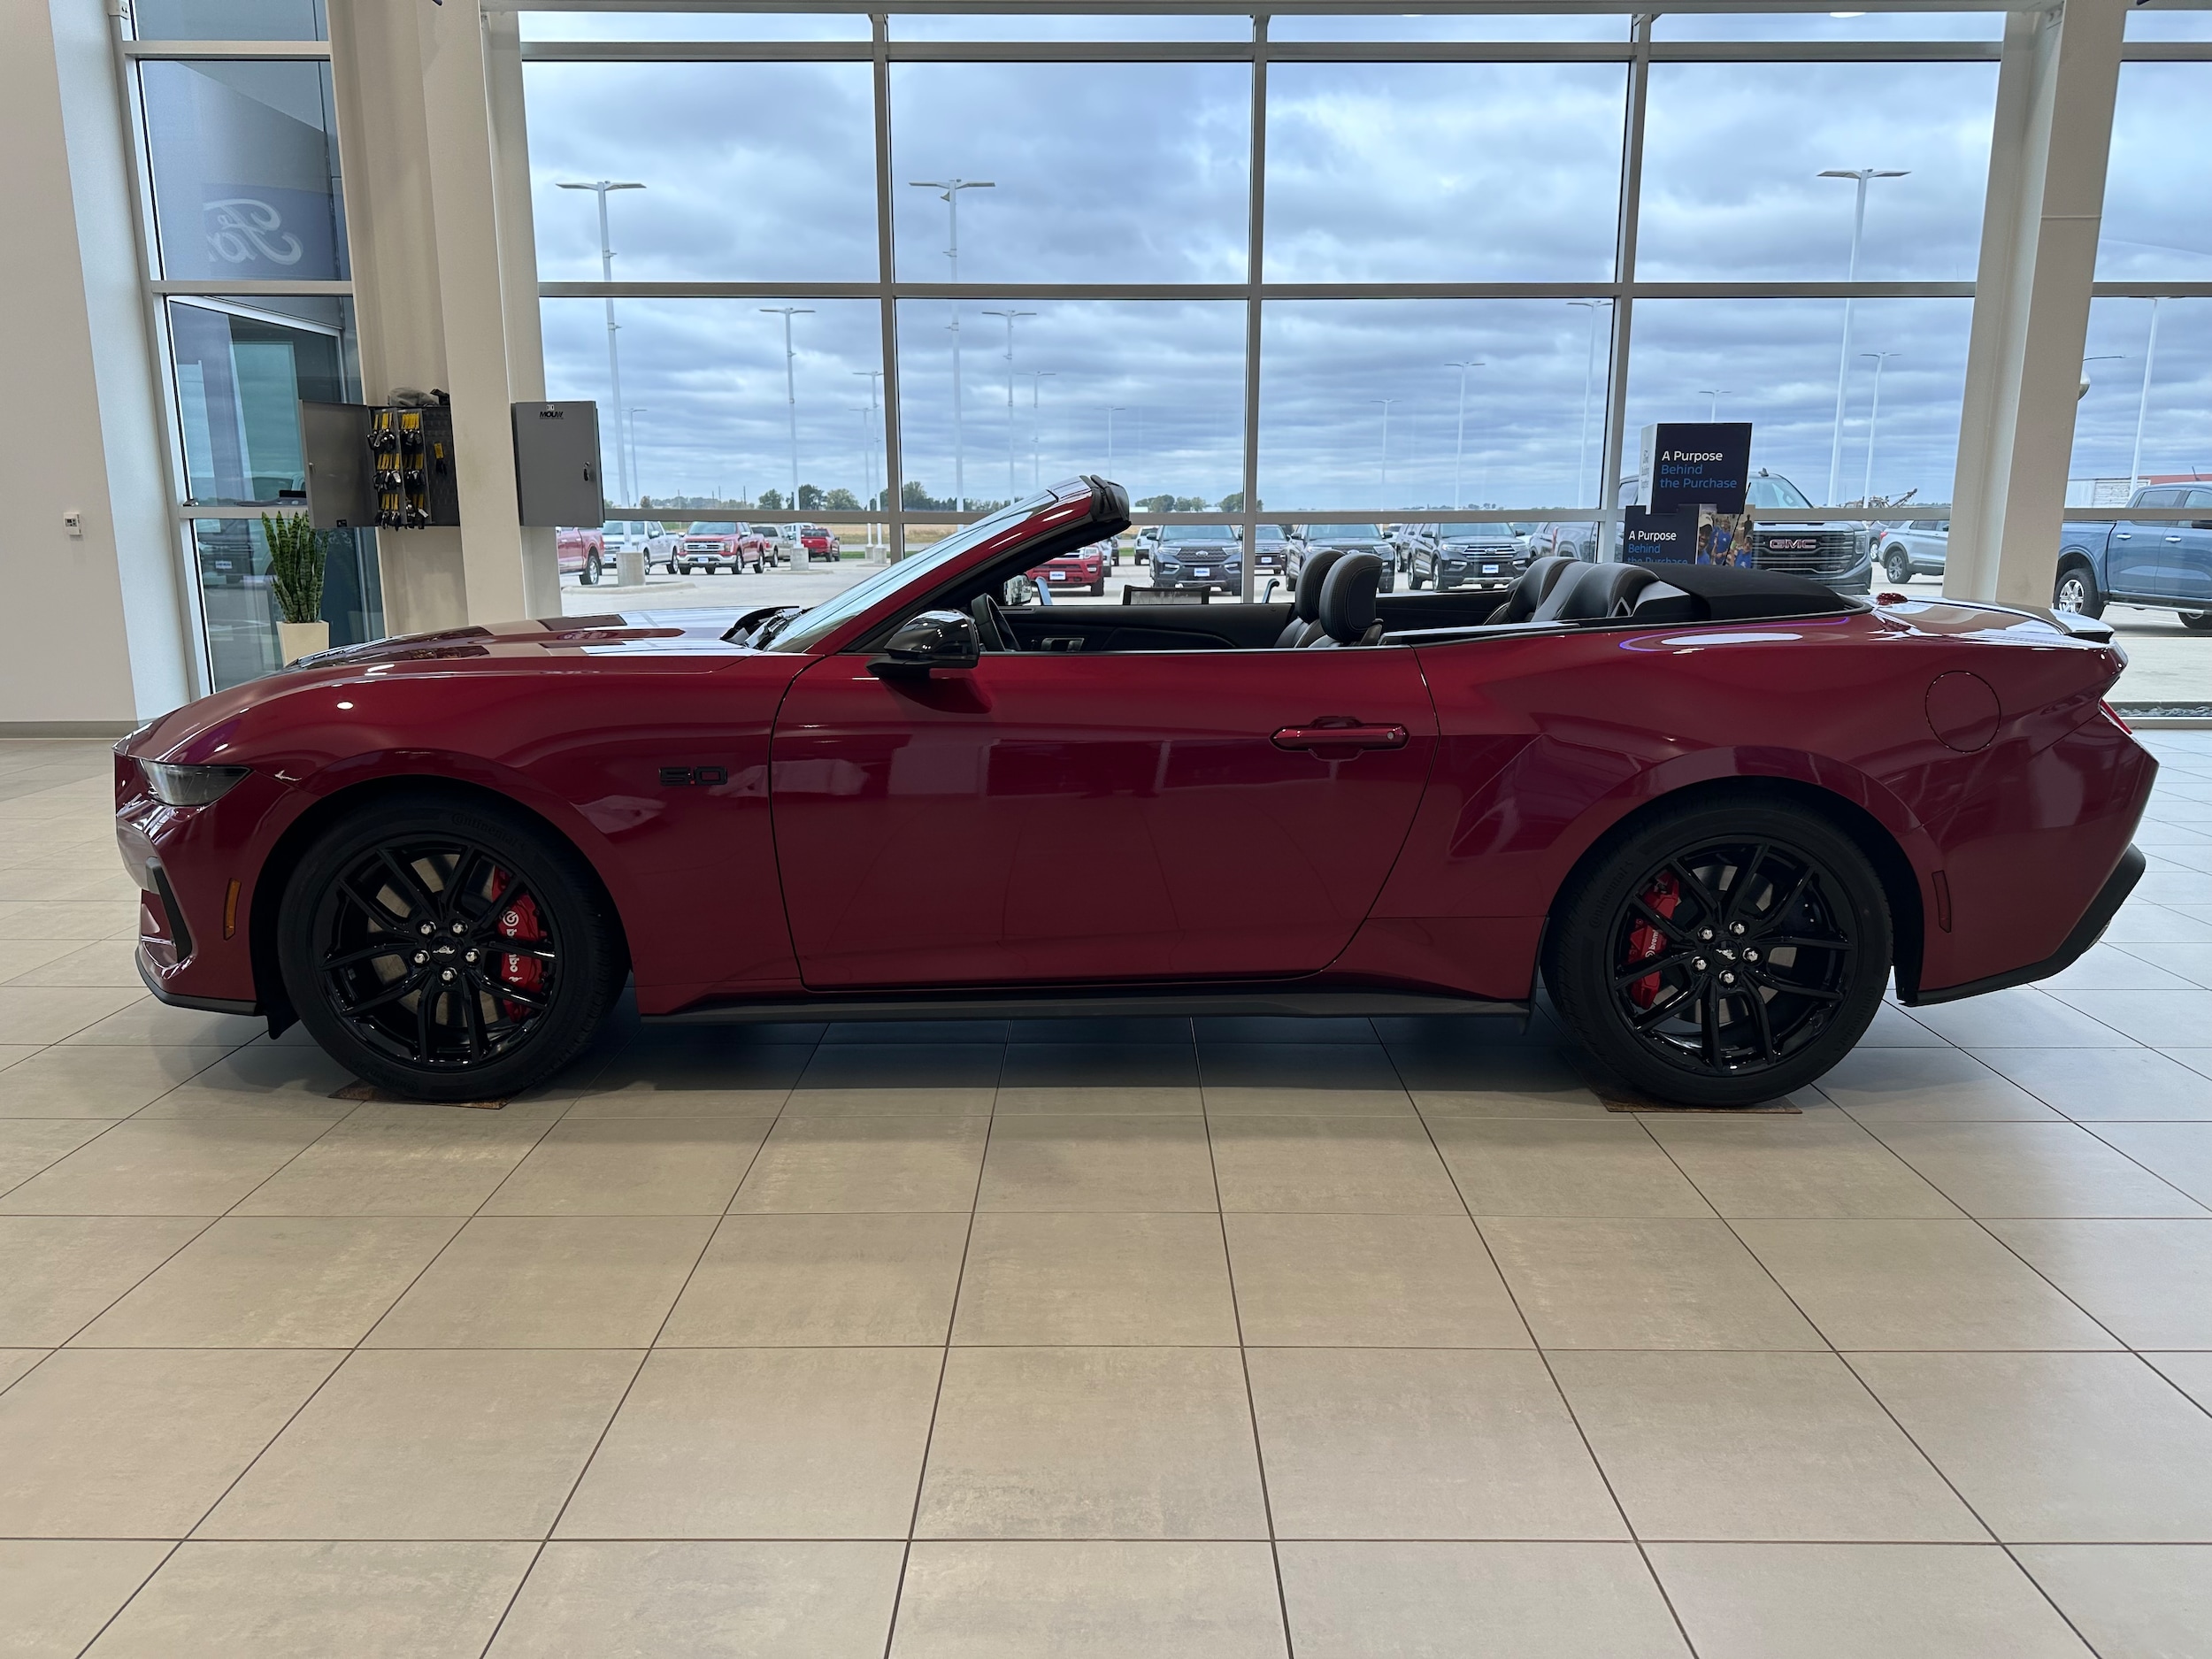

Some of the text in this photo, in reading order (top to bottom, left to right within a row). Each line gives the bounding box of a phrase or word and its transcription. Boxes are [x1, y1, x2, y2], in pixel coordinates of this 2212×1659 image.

[1662, 450, 1671, 461] A
[1674, 450, 1723, 463] Purpose
[1661, 465, 1703, 474] Behind
[1660, 478, 1679, 488] the
[1683, 478, 1737, 488] Purchase
[1628, 531, 1677, 542] A Purpose
[1628, 543, 1661, 554] Behind
[1770, 539, 1817, 549] GMC
